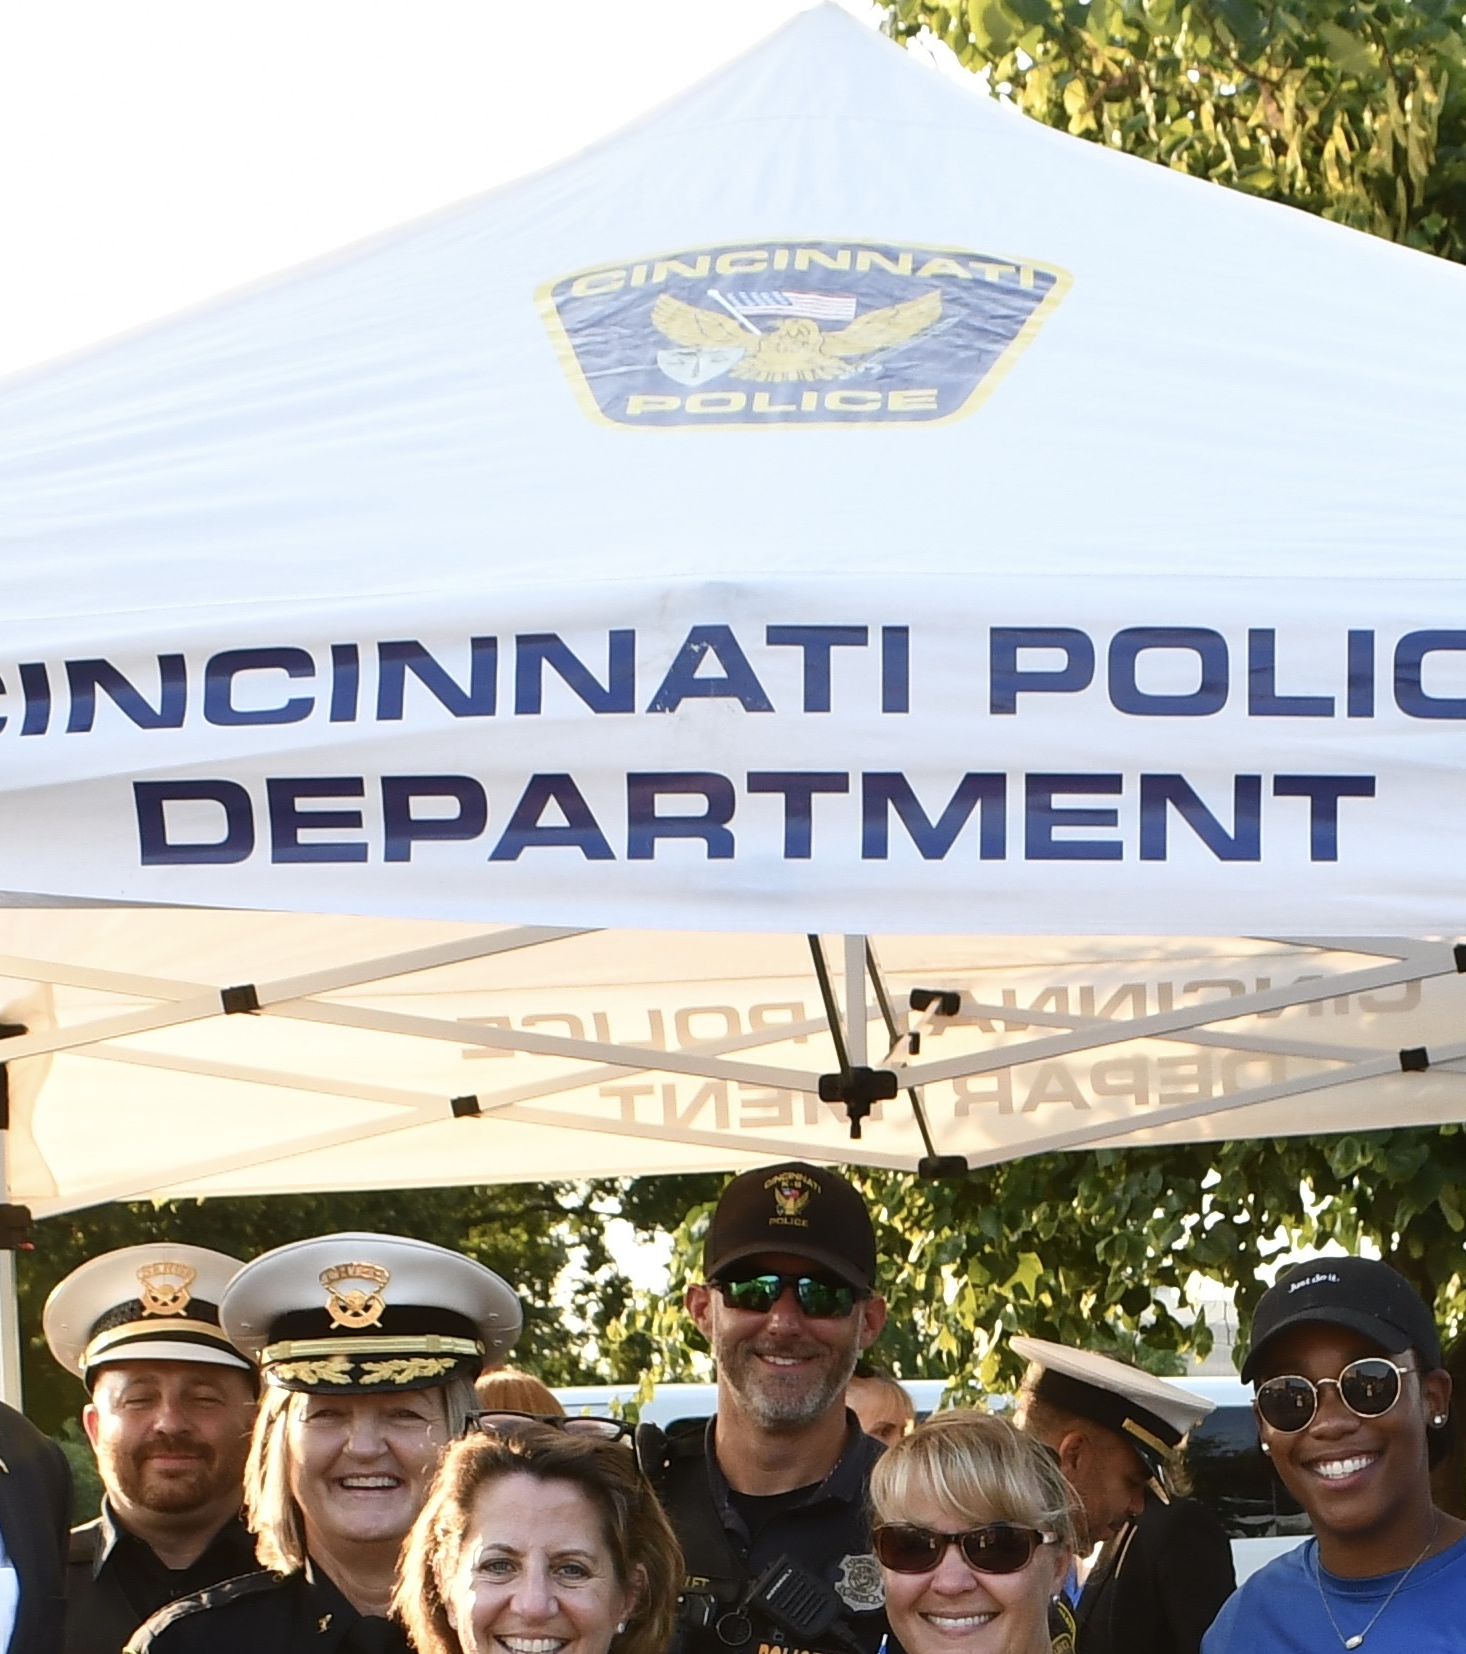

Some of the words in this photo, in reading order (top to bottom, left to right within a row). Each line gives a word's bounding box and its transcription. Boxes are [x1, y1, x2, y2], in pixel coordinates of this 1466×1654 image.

[569, 247, 1034, 298] CINCINNATI
[625, 389, 938, 415] POLICE
[132, 771, 1376, 867] DEPARTMENT
[768, 1217, 809, 1227] POLICE
[1311, 1273, 1327, 1284] do
